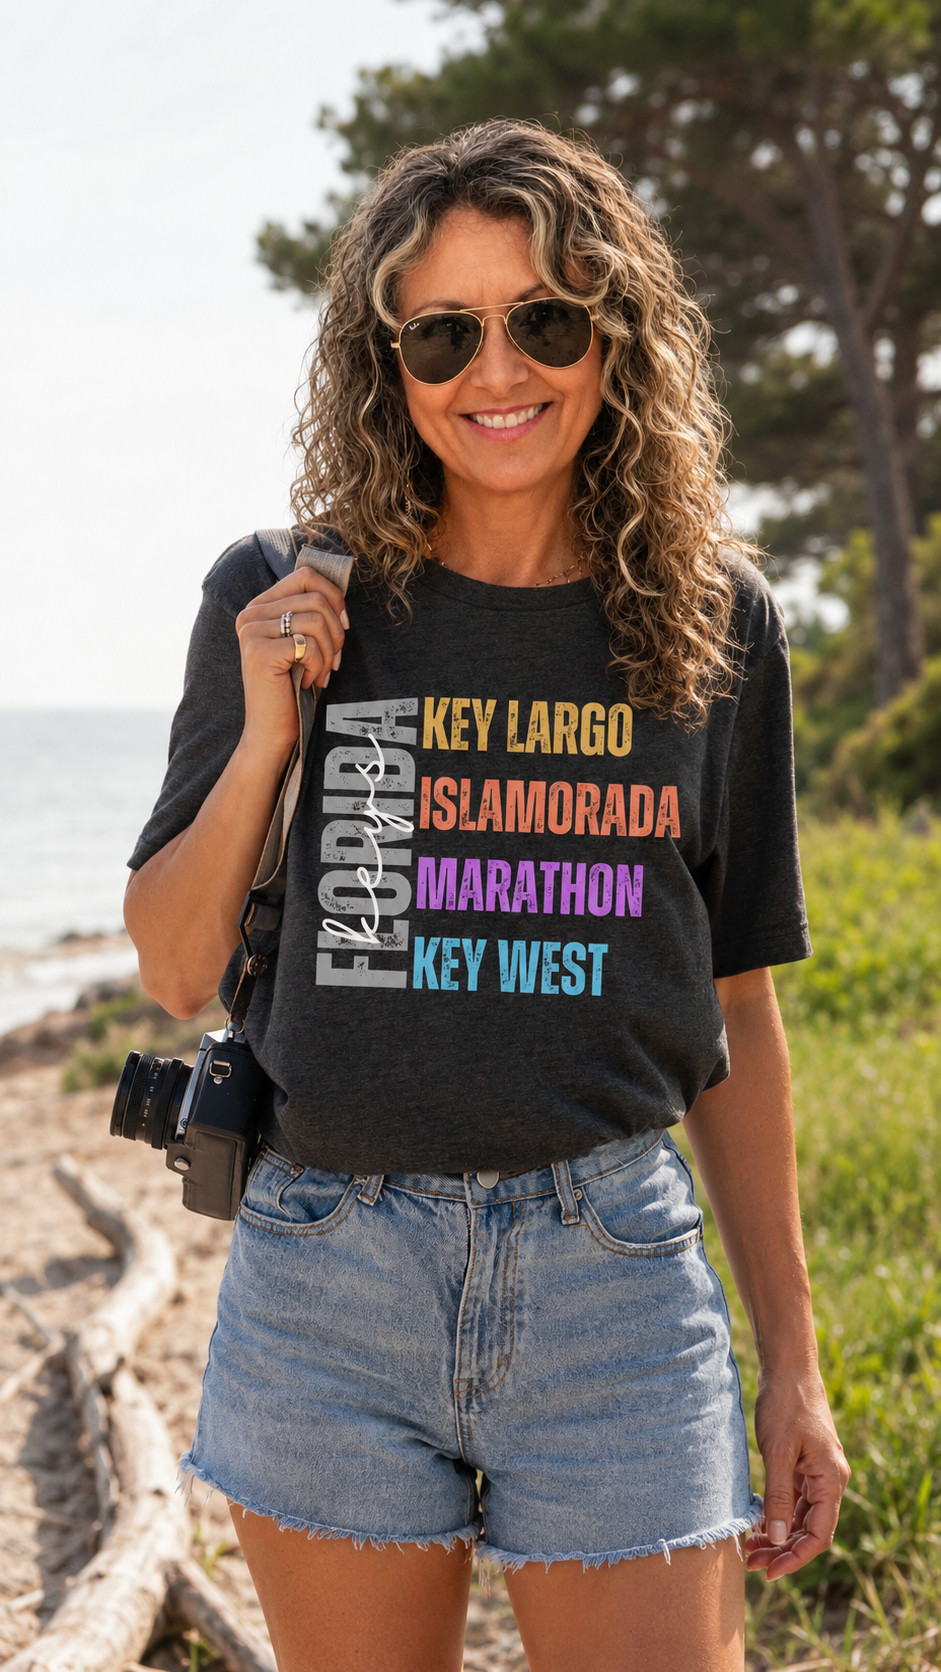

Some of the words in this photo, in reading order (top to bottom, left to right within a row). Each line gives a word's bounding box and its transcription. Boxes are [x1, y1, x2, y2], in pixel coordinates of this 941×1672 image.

[423, 697, 497, 751] KEY
[507, 700, 632, 757] LARGO
[420, 777, 680, 838] ISLAMORADA
[316, 698, 418, 989] FLORIDA
[321, 732, 415, 944] keys
[416, 857, 643, 917] MARATHON
[413, 937, 487, 991] KEY
[498, 940, 608, 996] WEST
